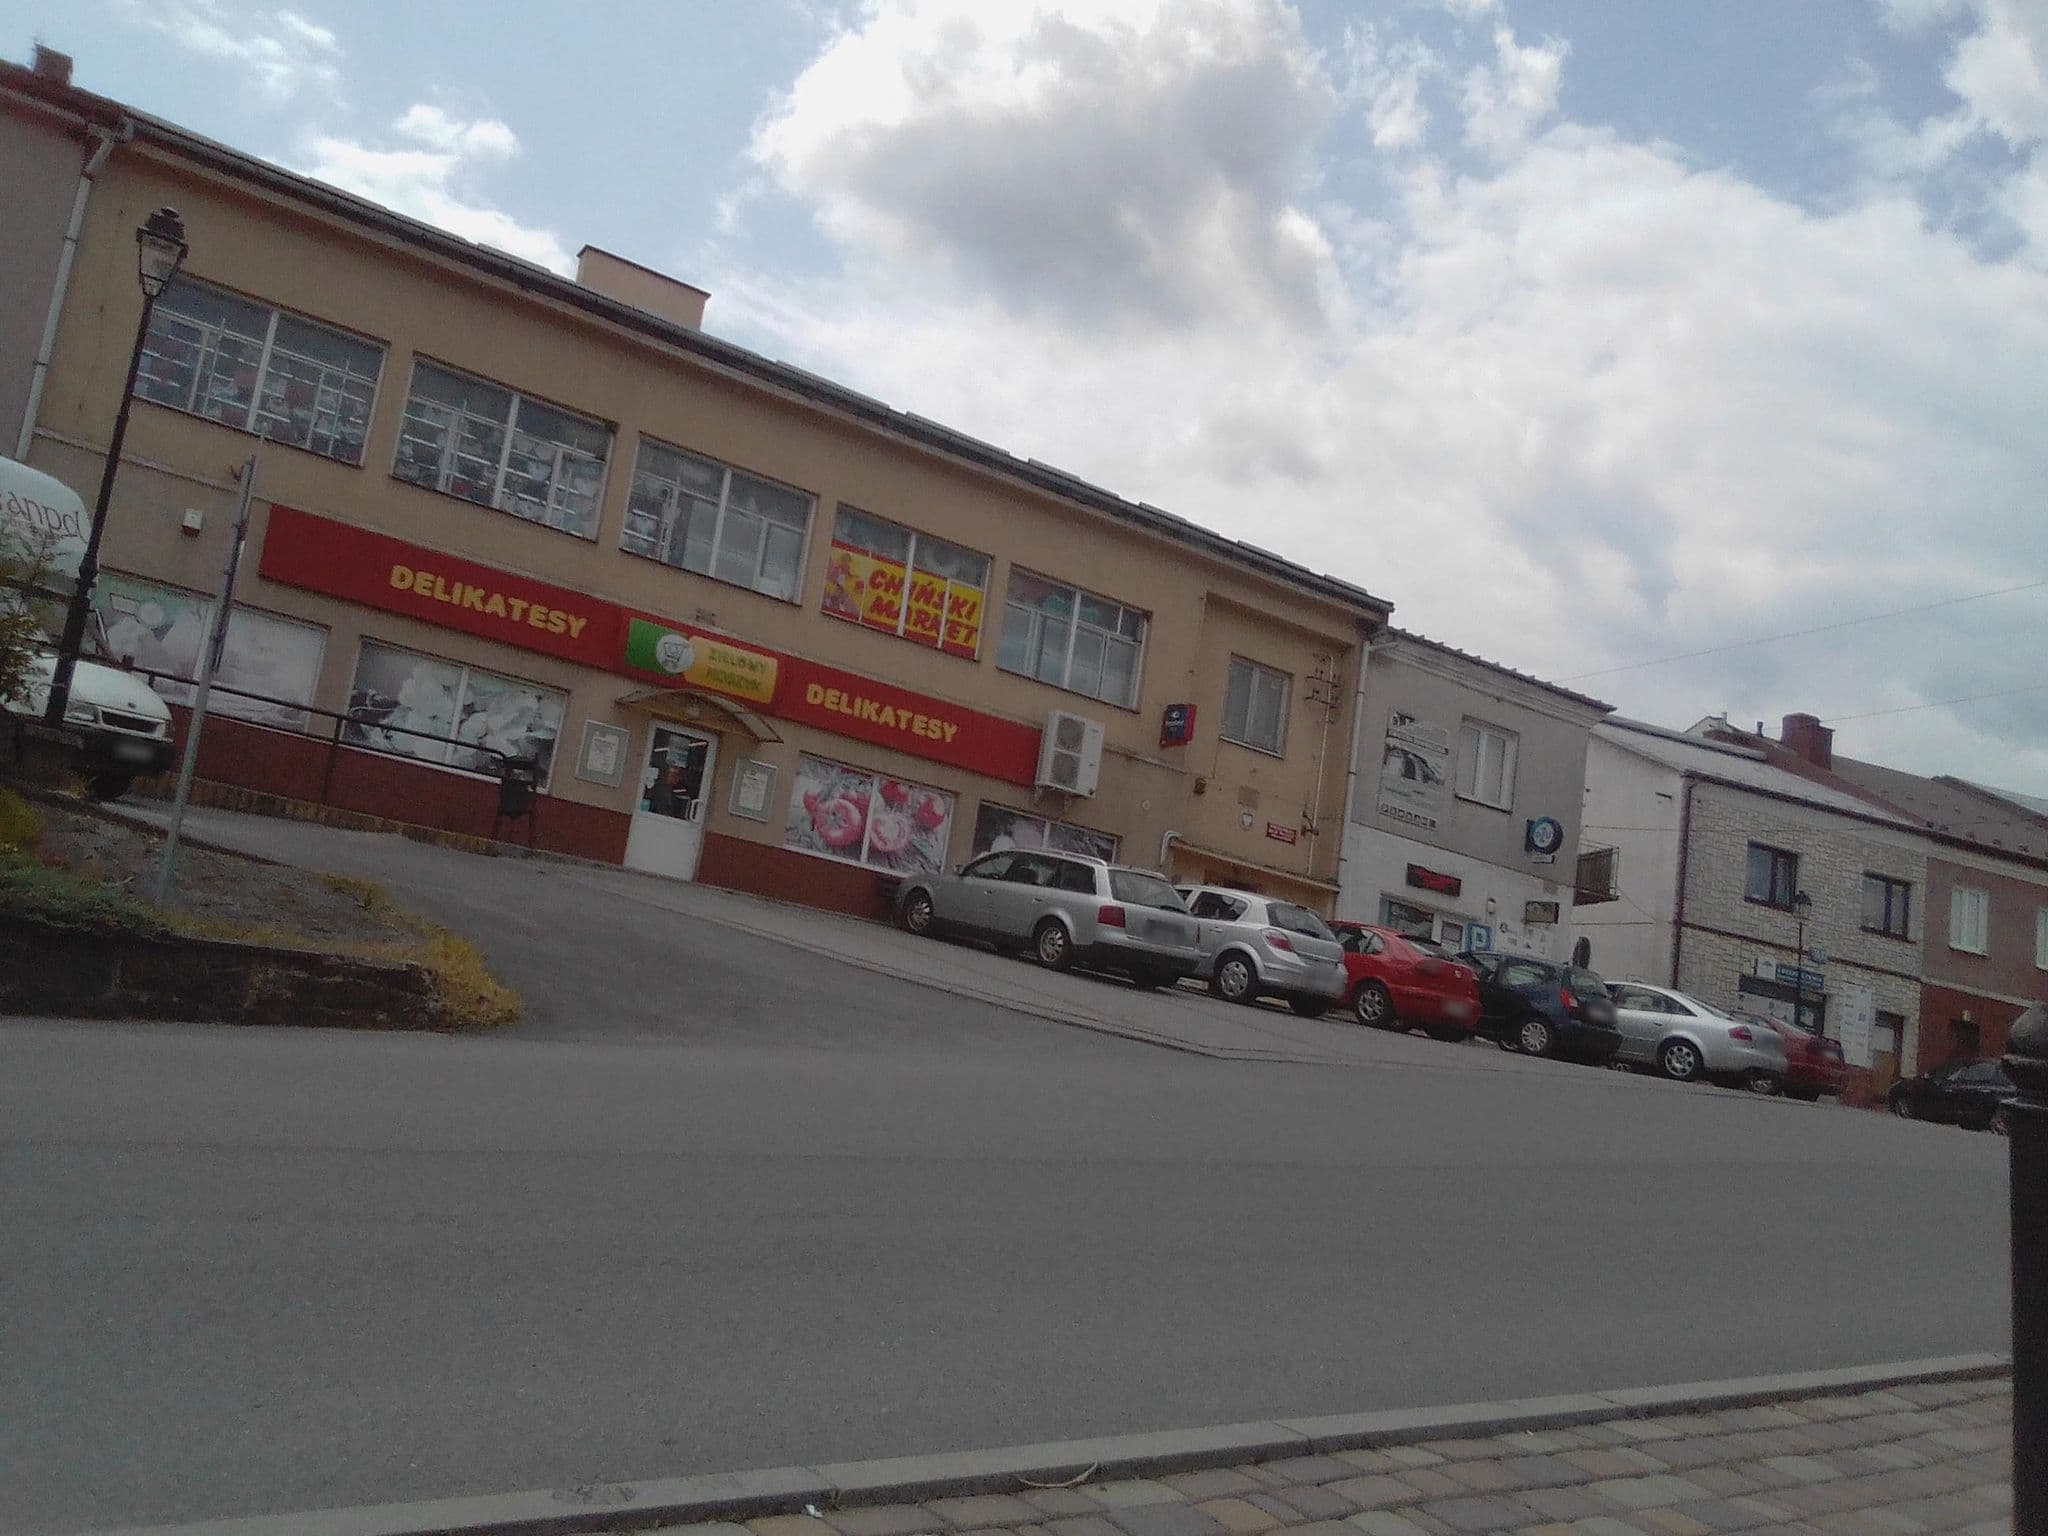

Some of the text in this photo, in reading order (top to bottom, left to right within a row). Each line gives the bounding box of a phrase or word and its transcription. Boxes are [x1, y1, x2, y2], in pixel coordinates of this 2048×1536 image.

[389, 564, 588, 640] DELIKATESY
[869, 568, 977, 621] CHIŃSKI
[869, 595, 978, 644] MARKET
[806, 682, 959, 743] DELIKATESY
